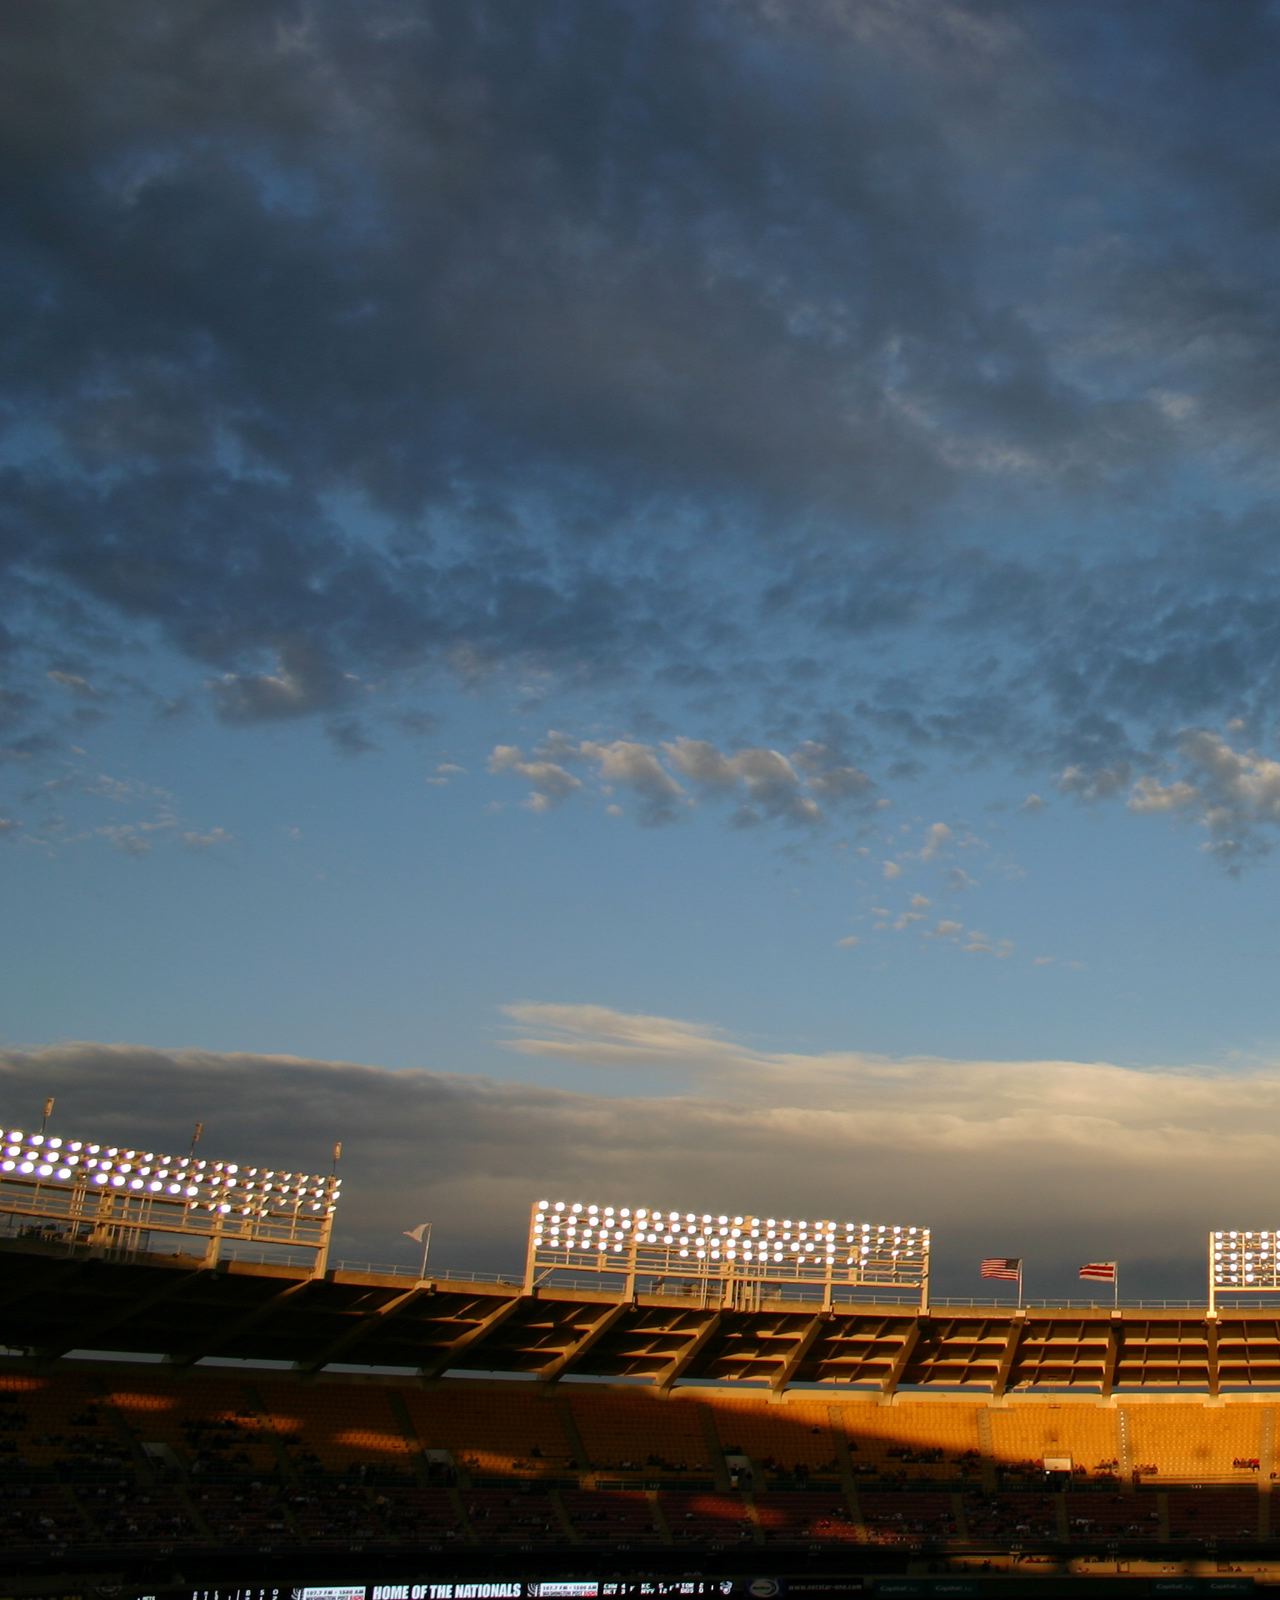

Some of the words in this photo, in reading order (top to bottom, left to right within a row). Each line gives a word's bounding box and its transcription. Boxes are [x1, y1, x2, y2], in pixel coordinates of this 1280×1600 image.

[373, 1585, 410, 1600] HOME
[411, 1585, 428, 1599] OF
[429, 1584, 453, 1599] THE
[454, 1583, 522, 1598] NATIONALS
